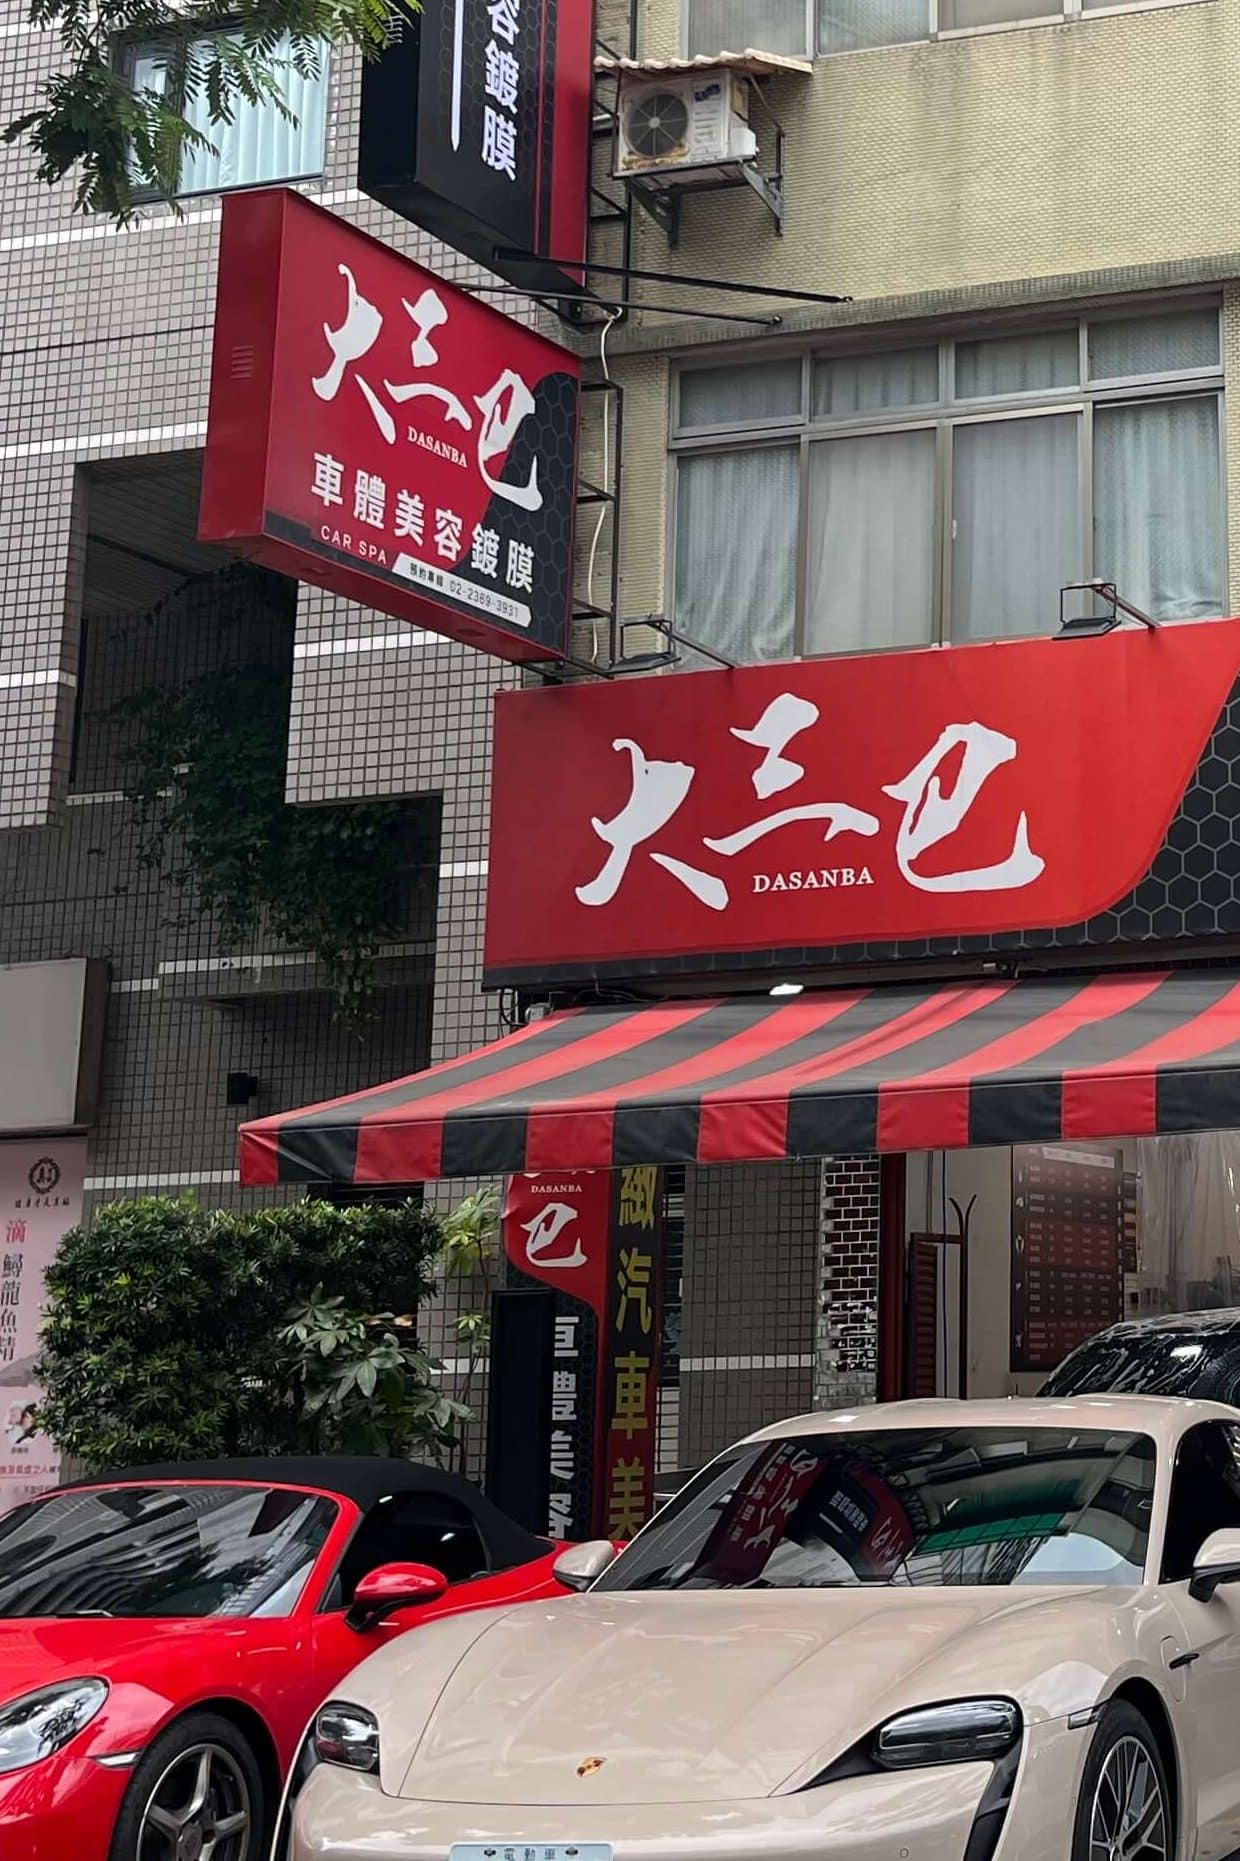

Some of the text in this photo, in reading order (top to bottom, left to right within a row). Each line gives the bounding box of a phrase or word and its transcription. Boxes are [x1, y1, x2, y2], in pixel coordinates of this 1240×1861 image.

[312, 263, 543, 511] 大三巴
[407, 425, 468, 468] DASANBA
[311, 452, 534, 594] 車體美容鍍膜
[320, 525, 388, 564] CAR SPA
[575, 692, 1046, 911] 大三巴
[752, 866, 874, 894] DASANBA
[531, 1184, 583, 1194] DASANBA
